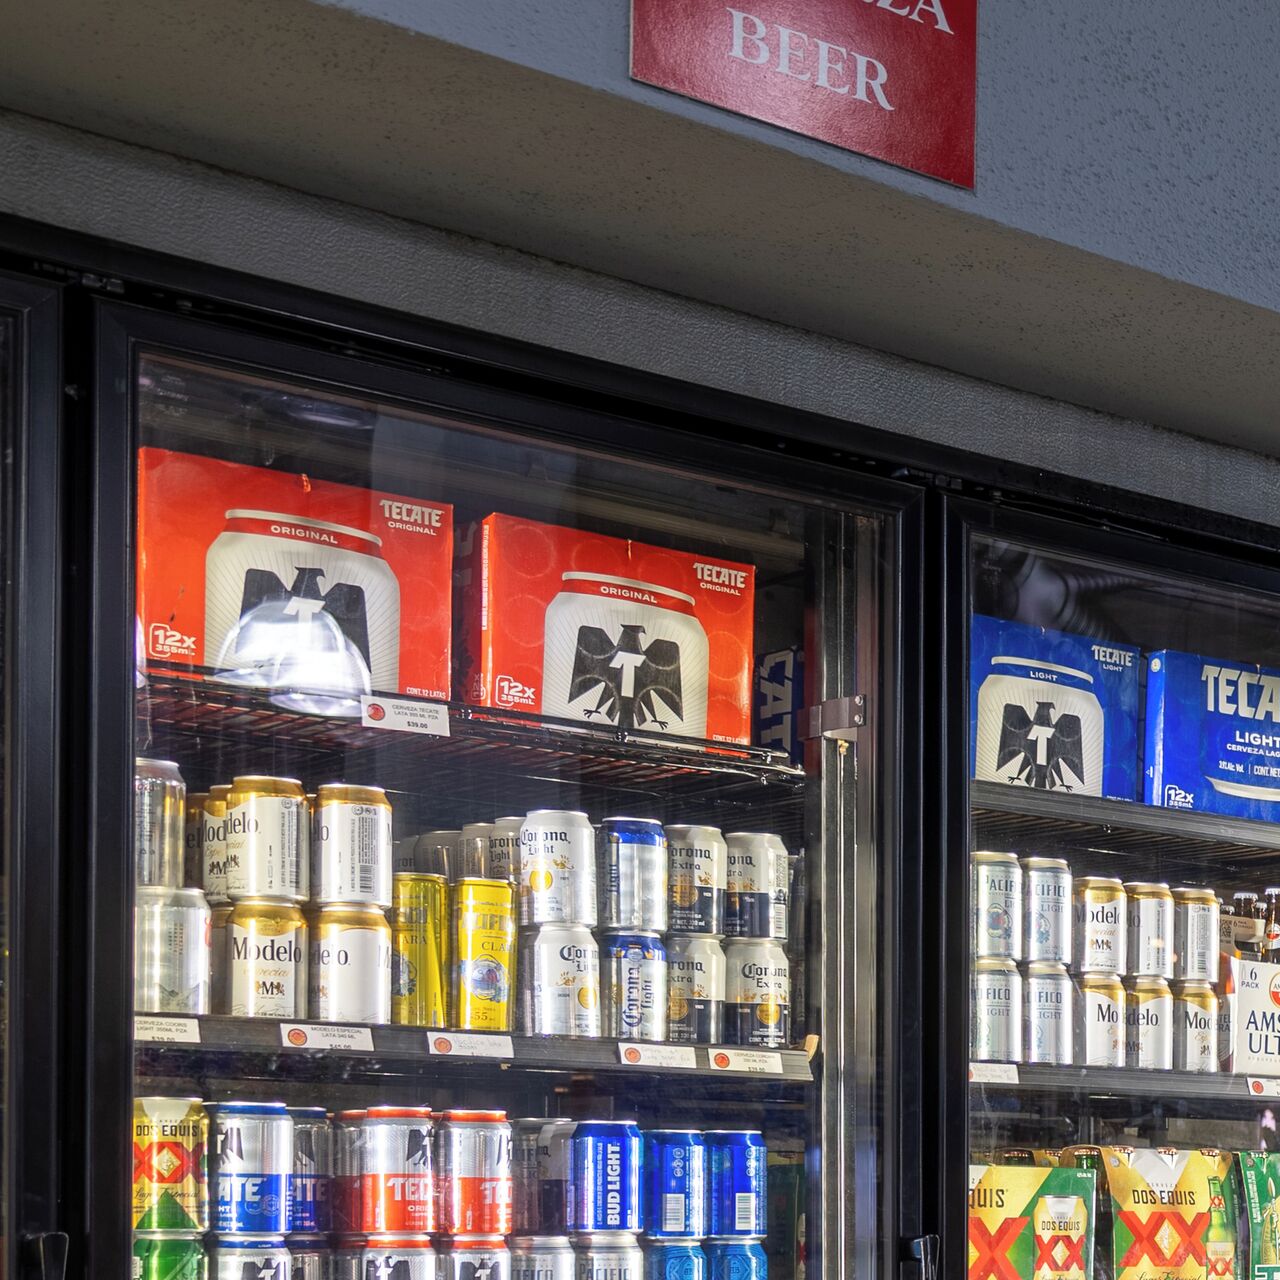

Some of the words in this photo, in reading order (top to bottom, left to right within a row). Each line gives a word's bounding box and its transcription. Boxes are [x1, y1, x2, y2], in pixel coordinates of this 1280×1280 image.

[727, 8, 894, 111] BEER
[380, 499, 445, 527] TECATE
[271, 525, 338, 544] ORIGINAL
[388, 521, 437, 535] ORIGINAL
[693, 563, 749, 588] TECATE
[600, 585, 657, 604] ORIGINAL
[700, 582, 741, 596] ORIGINAL
[154, 629, 196, 649] 12x
[1091, 645, 1135, 668] TECATE
[1029, 670, 1058, 682] LIGHT
[1102, 664, 1124, 672] LIGHT
[499, 681, 536, 699] 12x
[1226, 743, 1264, 755] CERVEZA
[1168, 788, 1194, 803] 12x
[520, 829, 571, 846] Corona
[231, 936, 303, 963] Modelo
[1249, 967, 1258, 980] 6
[1241, 981, 1259, 989] PACK
[162, 1125, 198, 1137] EQUIS
[607, 1143, 622, 1193] LIGHT
[1132, 1189, 1157, 1205] DOS
[1160, 1189, 1196, 1206] EQUIS
[607, 1194, 622, 1226] BUD
[1041, 1221, 1057, 1231] DOS
[1058, 1221, 1080, 1231] EQUIS
